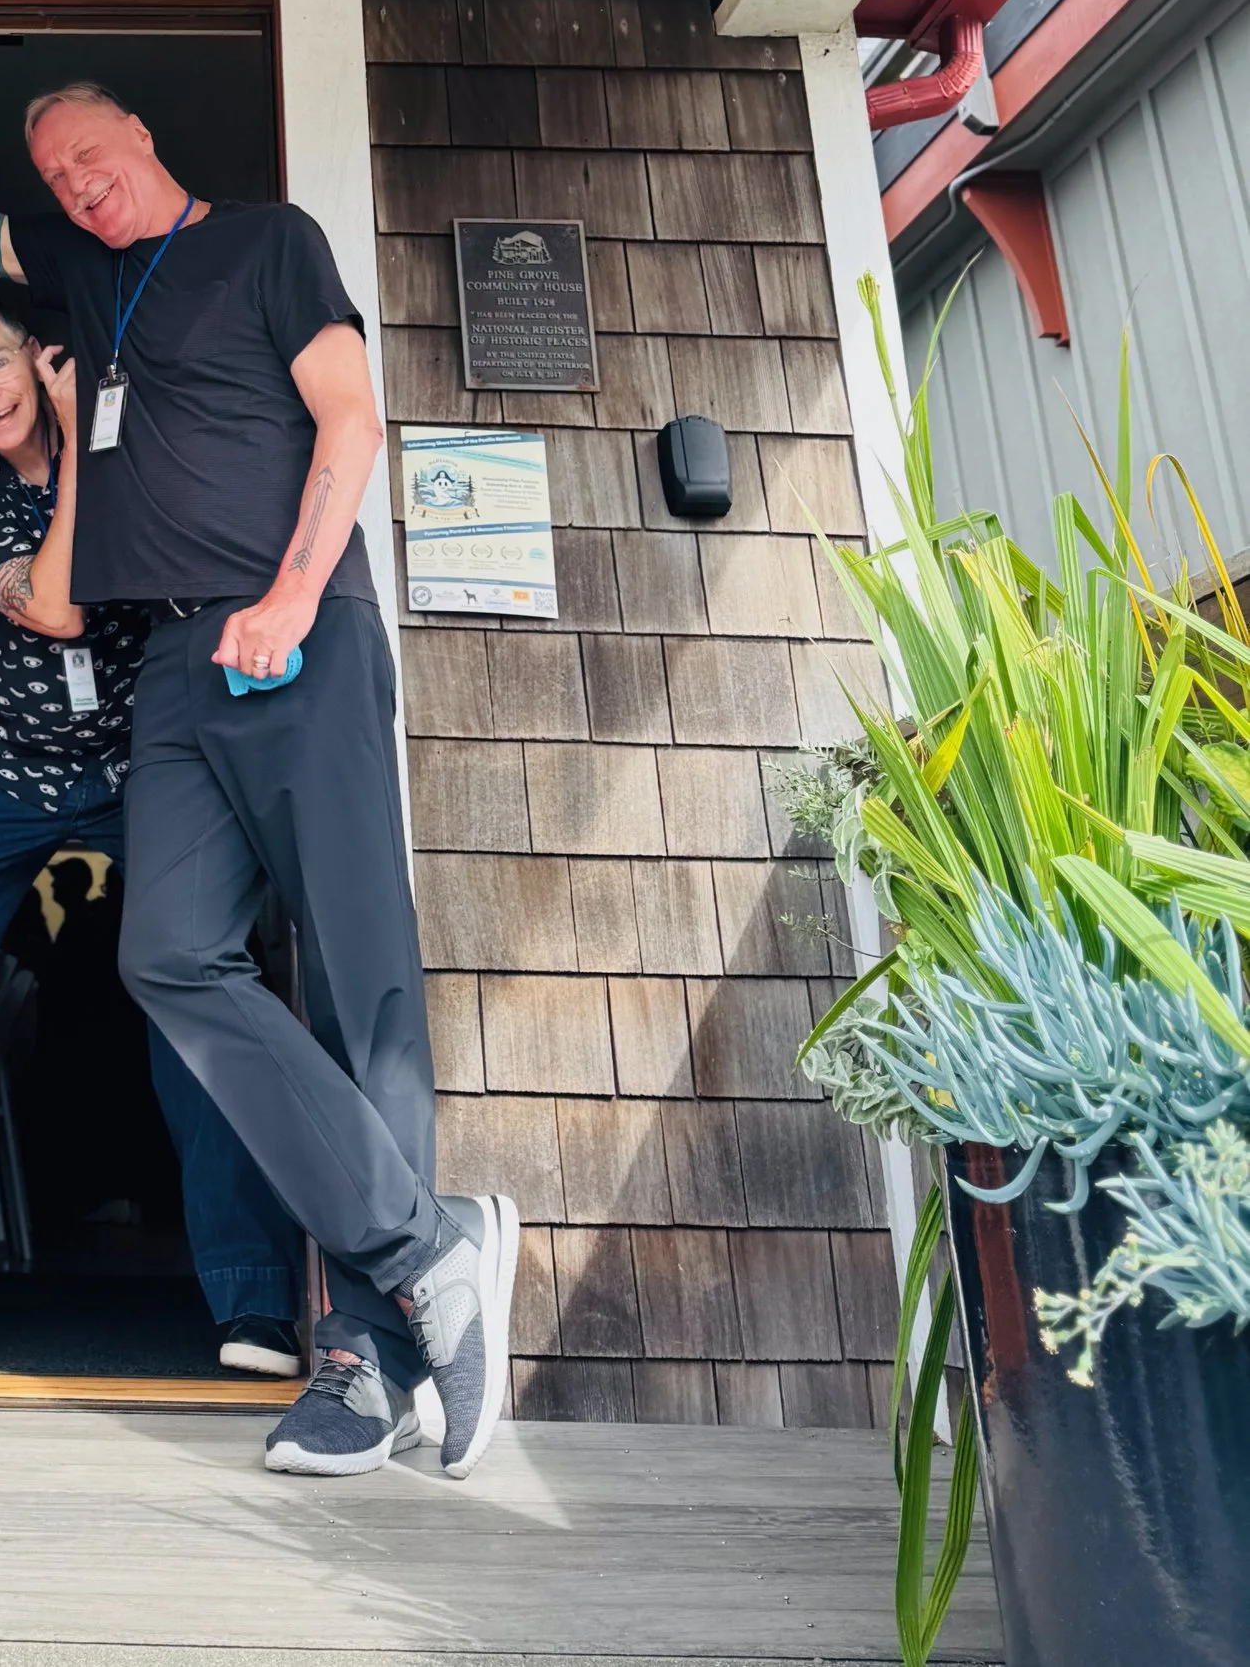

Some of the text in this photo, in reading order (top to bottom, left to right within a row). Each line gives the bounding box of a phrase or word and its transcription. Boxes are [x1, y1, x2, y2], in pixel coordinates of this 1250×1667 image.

[488, 270, 560, 280] PINE GROVE
[466, 281, 583, 292] COMMUNITY HOUSE
[497, 297, 555, 306] BUILT 1928
[517, 312, 547, 320] PLACED
[471, 324, 586, 335] NATIONAL REGISTER
[470, 335, 589, 347] OF HISTORIC PLACES
[500, 351, 515, 359] THE
[517, 351, 546, 359] UNITED
[548, 352, 575, 360] STATES
[472, 360, 522, 368] DEPARTMENT
[537, 361, 552, 369] THE
[554, 361, 591, 370] INTERIOR
[501, 370, 514, 378] ON
[516, 371, 533, 379] JULY
